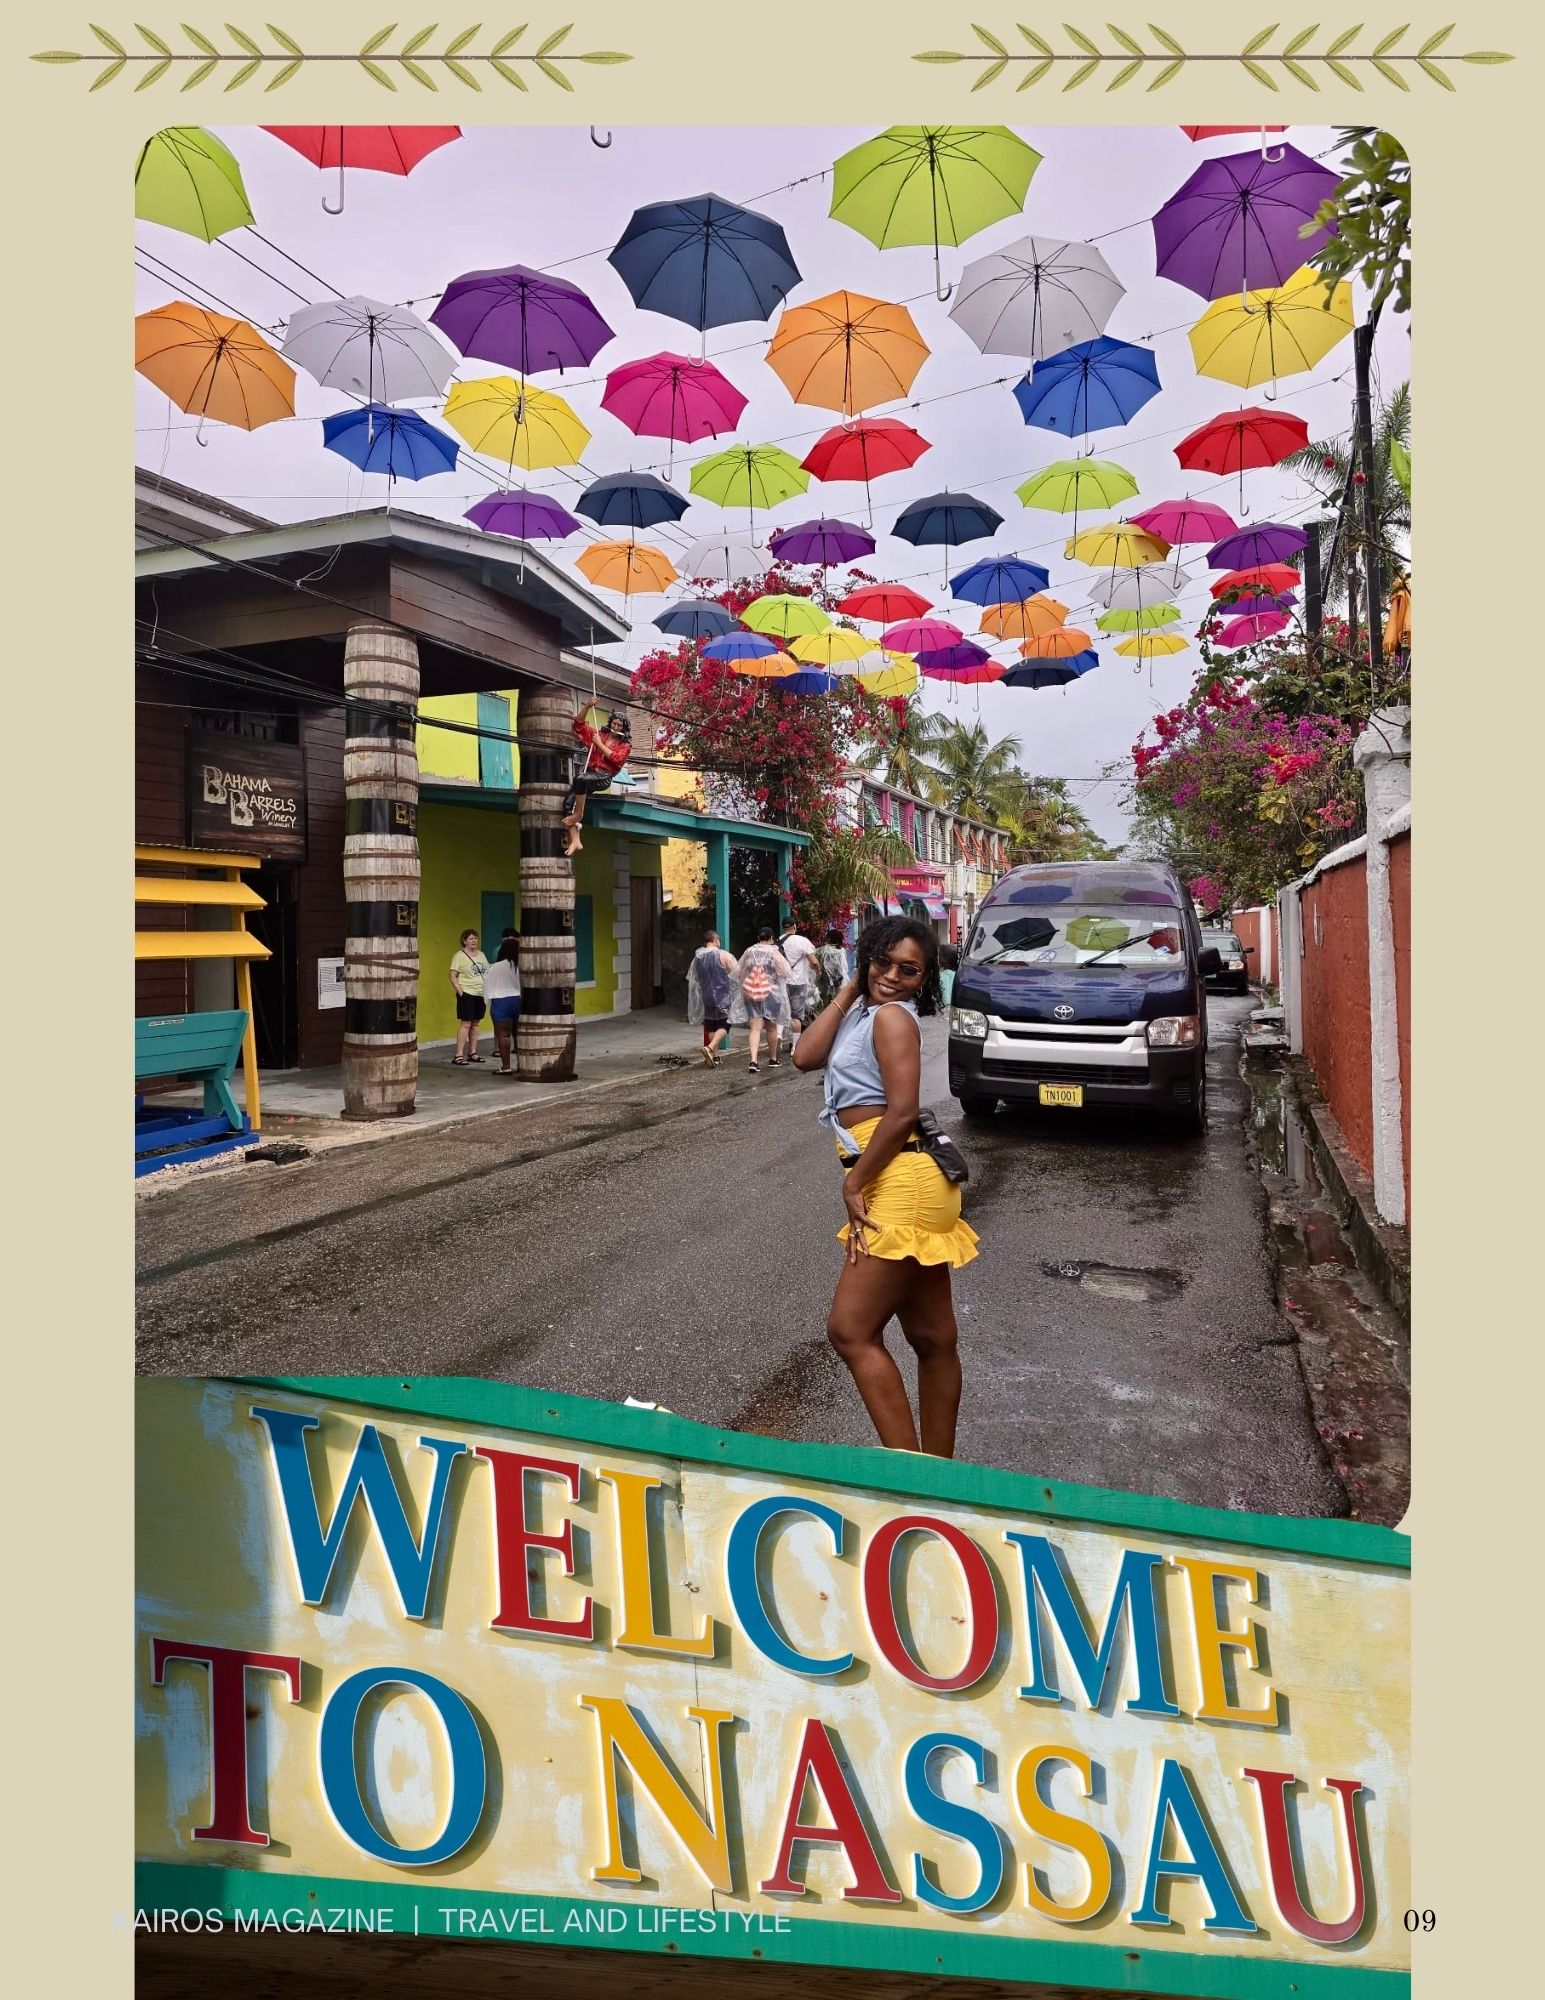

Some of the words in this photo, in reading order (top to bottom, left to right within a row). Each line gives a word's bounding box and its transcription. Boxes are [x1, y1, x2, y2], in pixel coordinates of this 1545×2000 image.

[202, 765, 272, 804] BAHAMA
[228, 788, 297, 826] BARRELS
[261, 808, 297, 828] Winery
[1045, 1090, 1076, 1102] TN1001
[248, 1404, 1280, 1729] WELCOME
[150, 1637, 487, 1868] TO
[576, 1692, 1369, 1948] NASSAU
